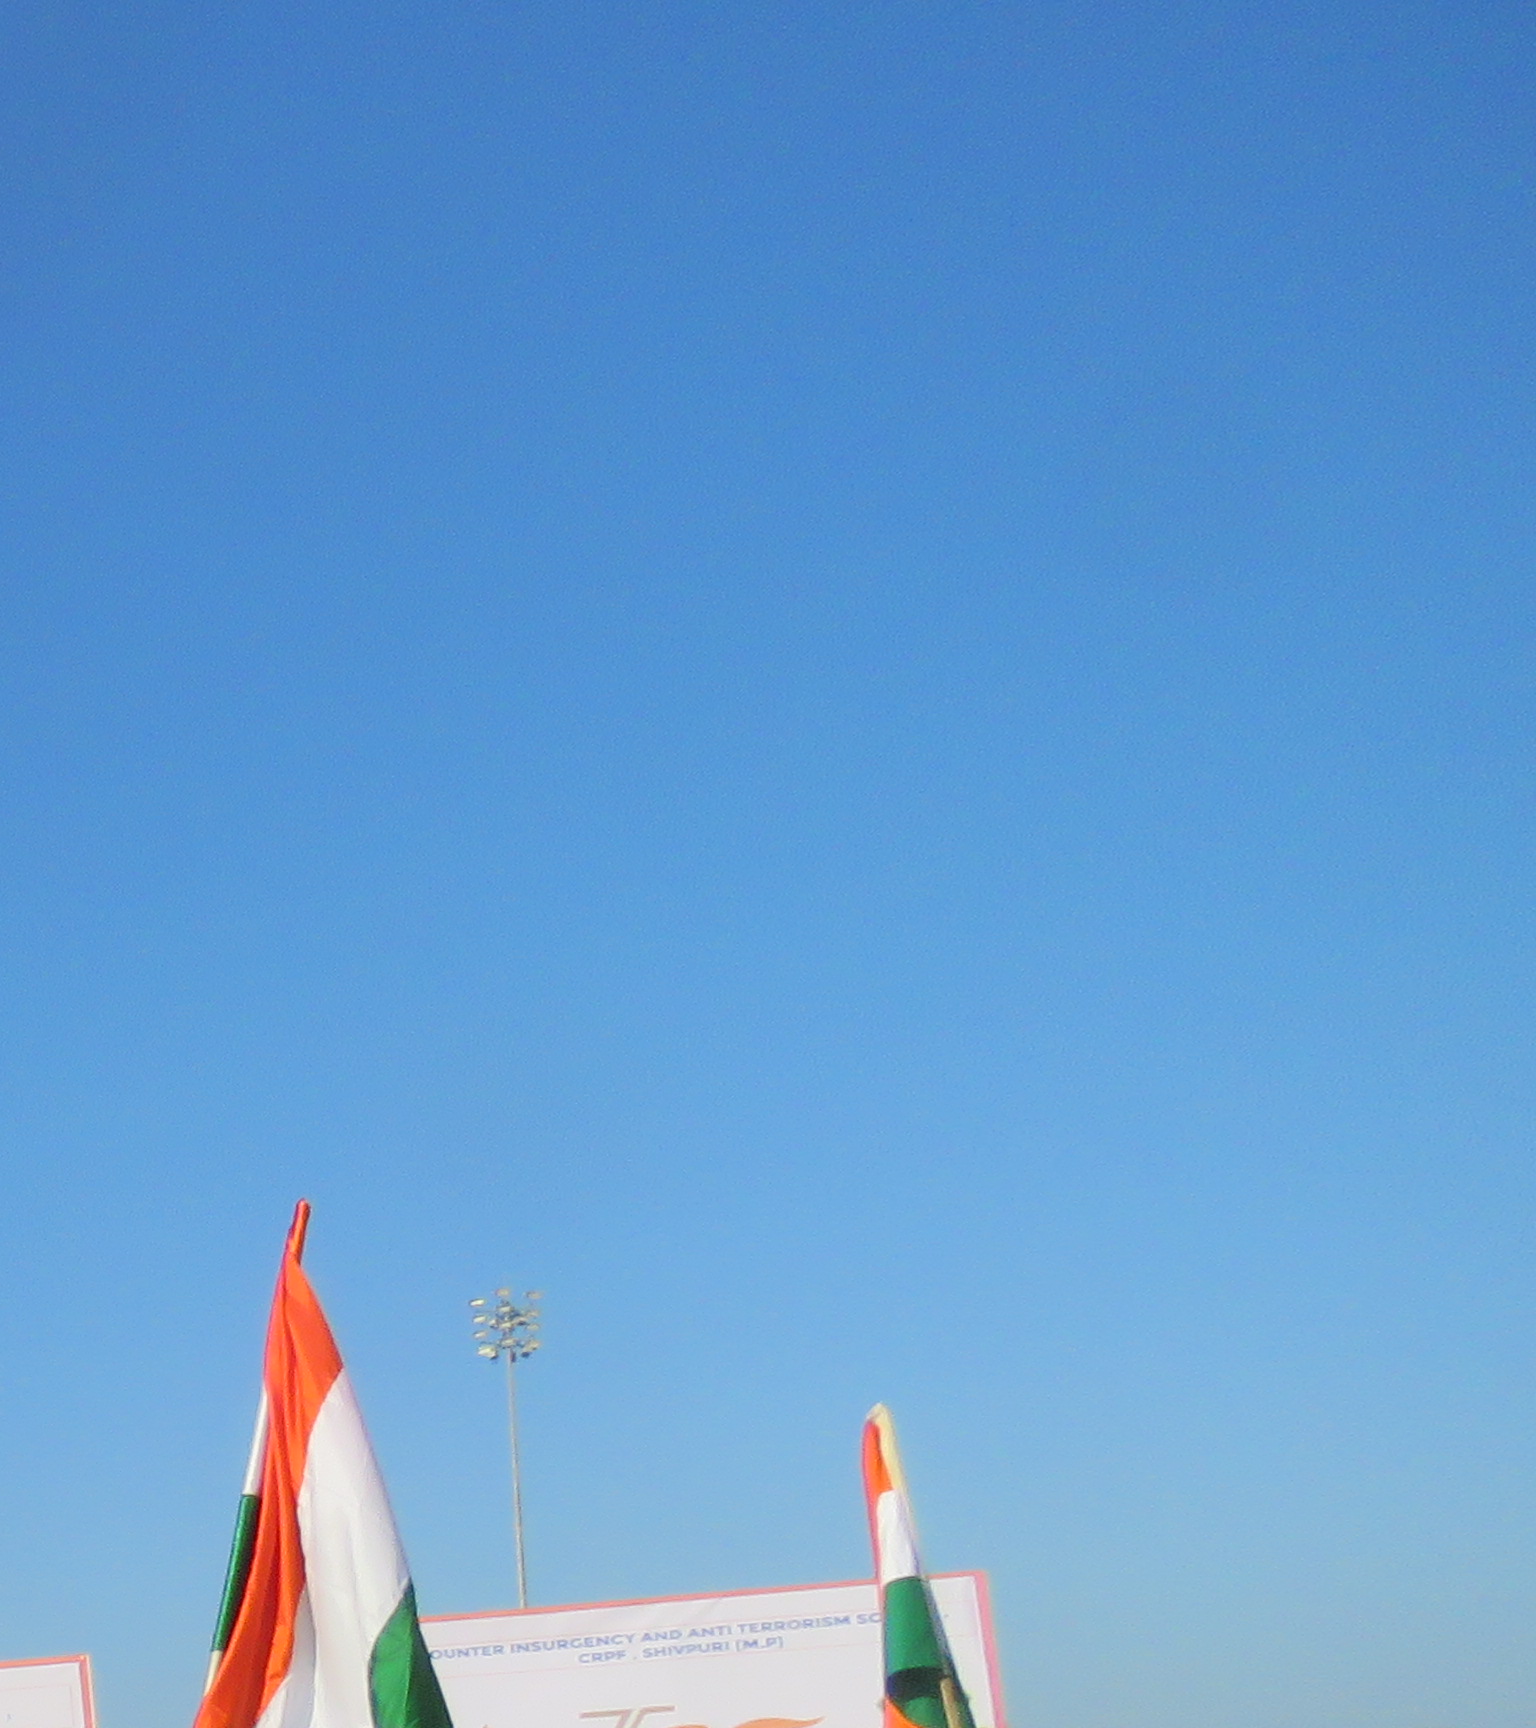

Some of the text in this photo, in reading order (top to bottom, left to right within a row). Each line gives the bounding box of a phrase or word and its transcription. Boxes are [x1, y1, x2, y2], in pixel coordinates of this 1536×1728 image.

[430, 1644, 505, 1660] OUNTER
[510, 1633, 636, 1655] INSURGENCY
[641, 1628, 683, 1643] AND
[688, 1624, 732, 1639] ANTI
[737, 1614, 851, 1635] TERRORISM
[578, 1650, 627, 1664] CRPF
[642, 1641, 731, 1659] SHIVPURI
